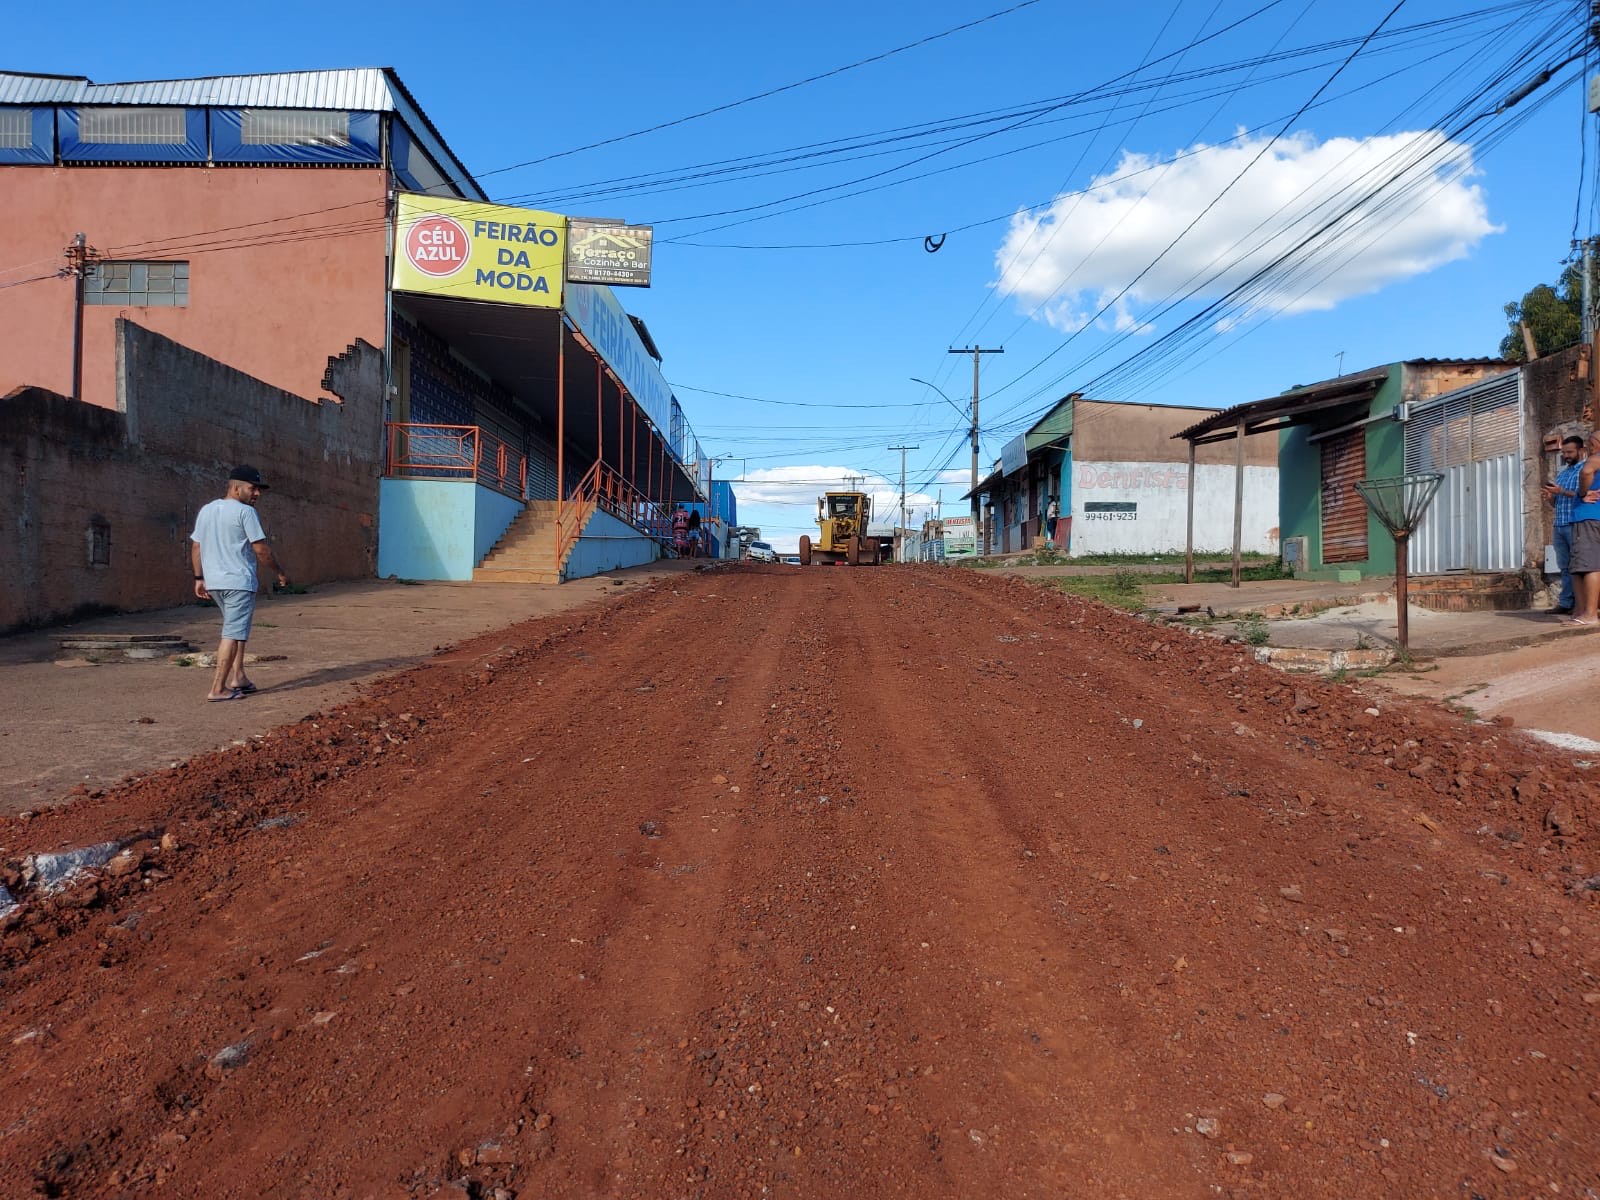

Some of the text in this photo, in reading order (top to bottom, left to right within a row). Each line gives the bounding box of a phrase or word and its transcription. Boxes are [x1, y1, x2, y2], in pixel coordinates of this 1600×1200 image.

[418, 226, 455, 245] CÉU
[474, 220, 558, 247] FEIRÃO
[415, 246, 461, 262] AZUL
[497, 248, 531, 269] DA
[571, 244, 636, 262] Terraço
[583, 257, 621, 267] Cozinha
[631, 260, 648, 269] Bar
[475, 268, 550, 294] MODA
[593, 287, 633, 382] FEIRÃO
[634, 351, 646, 402] DA
